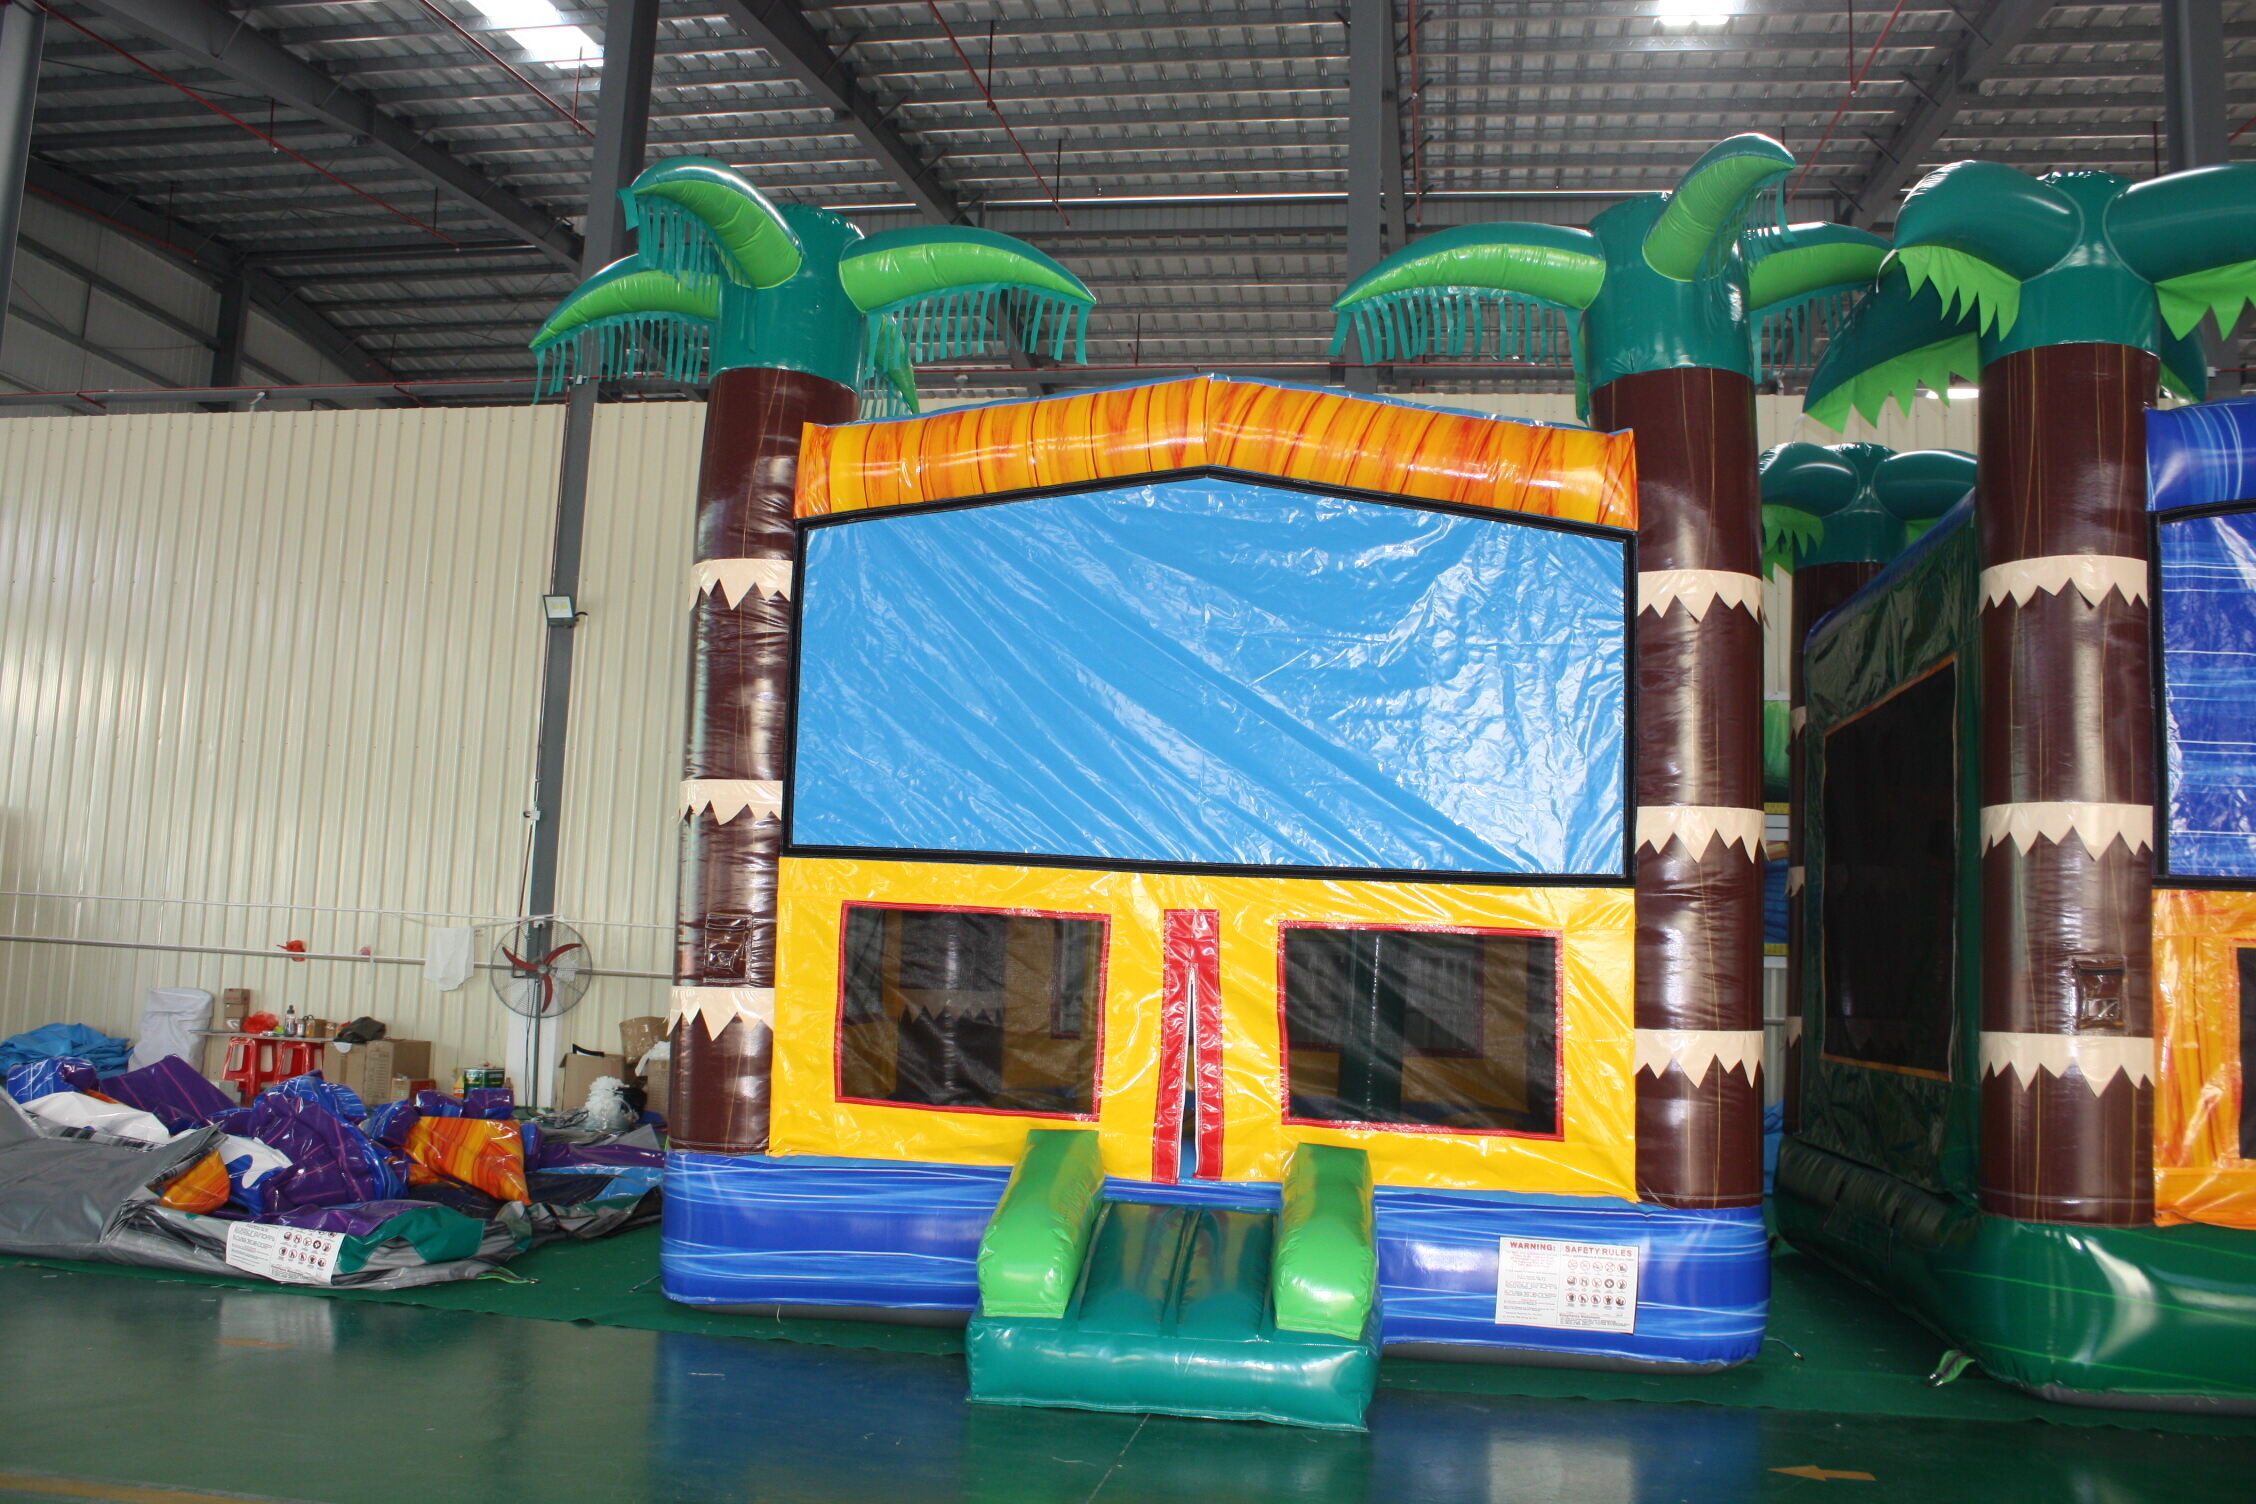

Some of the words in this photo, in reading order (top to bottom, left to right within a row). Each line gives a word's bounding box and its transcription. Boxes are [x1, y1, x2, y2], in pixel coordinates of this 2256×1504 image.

[1510, 1241, 1556, 1251] WARNING:
[1565, 1246, 1601, 1255] SAFETY
[1602, 1248, 1633, 1257] RULES
